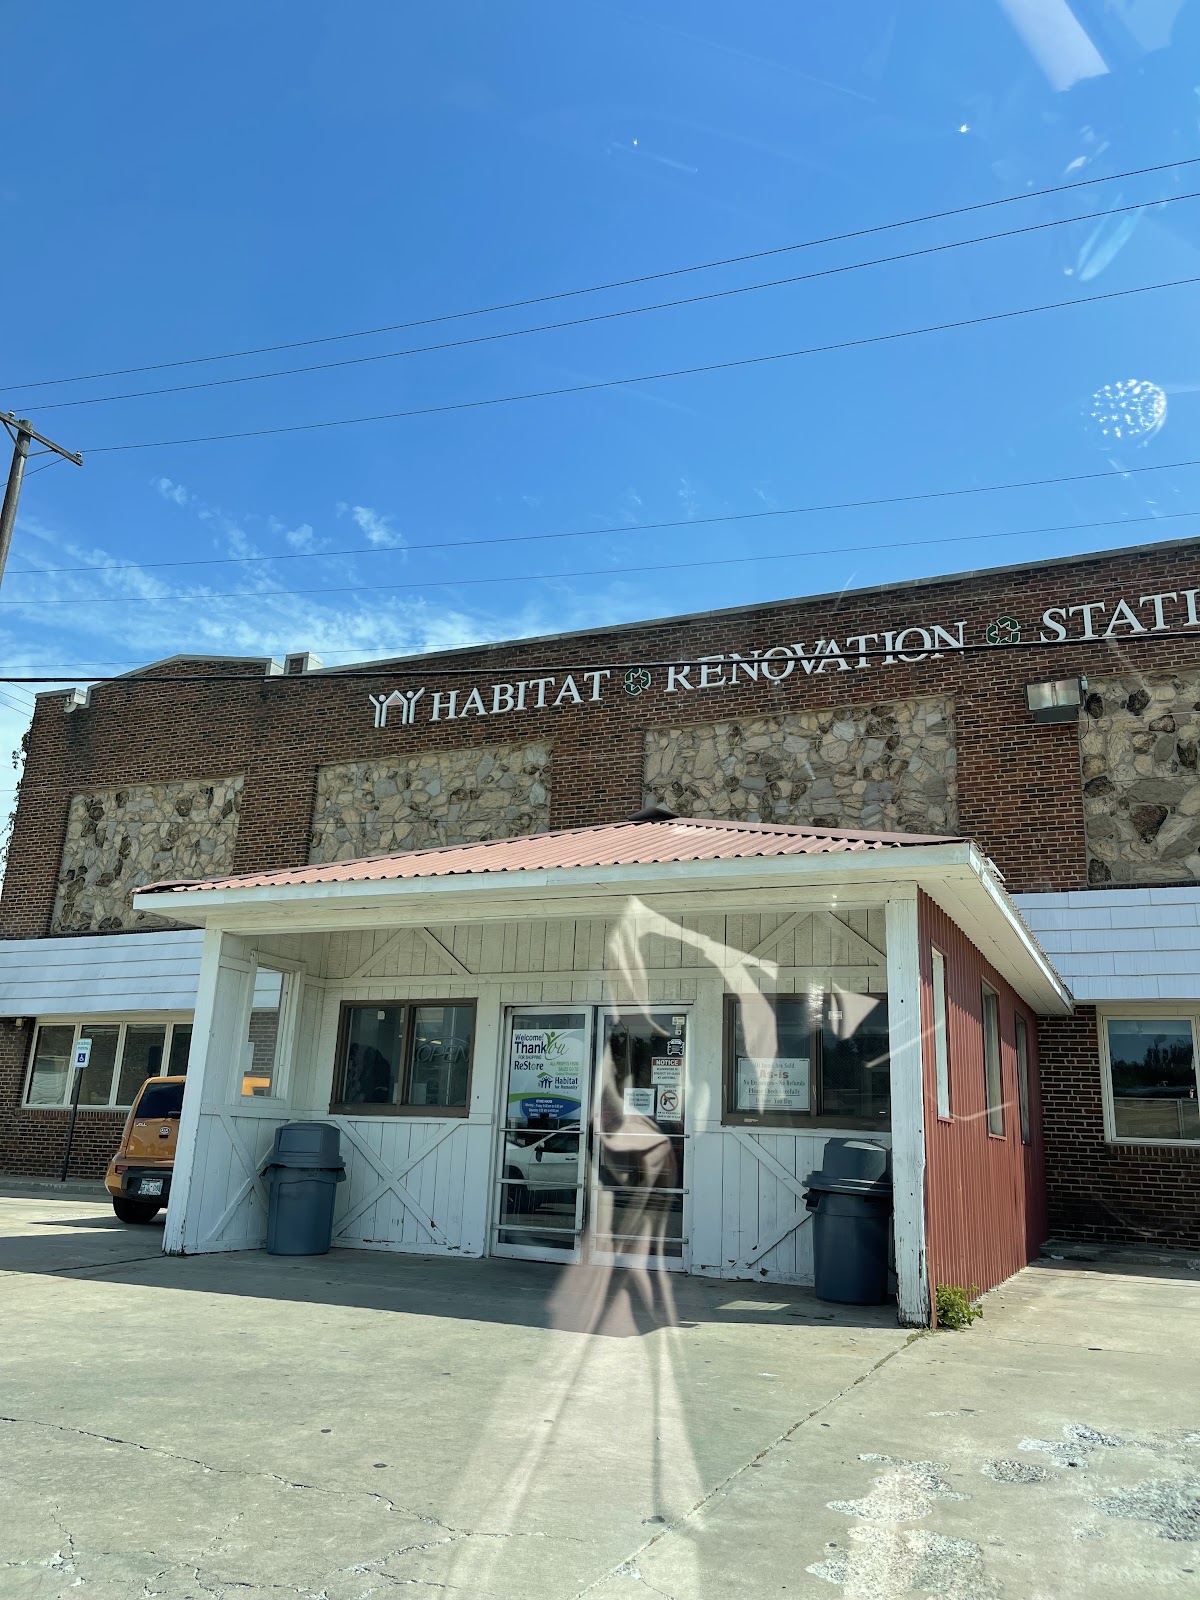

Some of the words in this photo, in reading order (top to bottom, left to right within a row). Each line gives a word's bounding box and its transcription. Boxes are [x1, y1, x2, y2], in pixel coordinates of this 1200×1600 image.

[429, 669, 611, 722] HABITAT
[663, 621, 968, 692] RENOVATION
[1040, 588, 1200, 642] STATI
[417, 1045, 469, 1062] OPEN
[514, 1041, 546, 1054] Thank
[514, 1060, 544, 1071] ReStore
[759, 1069, 789, 1079] As-is
[555, 1076, 578, 1085] Habitat
